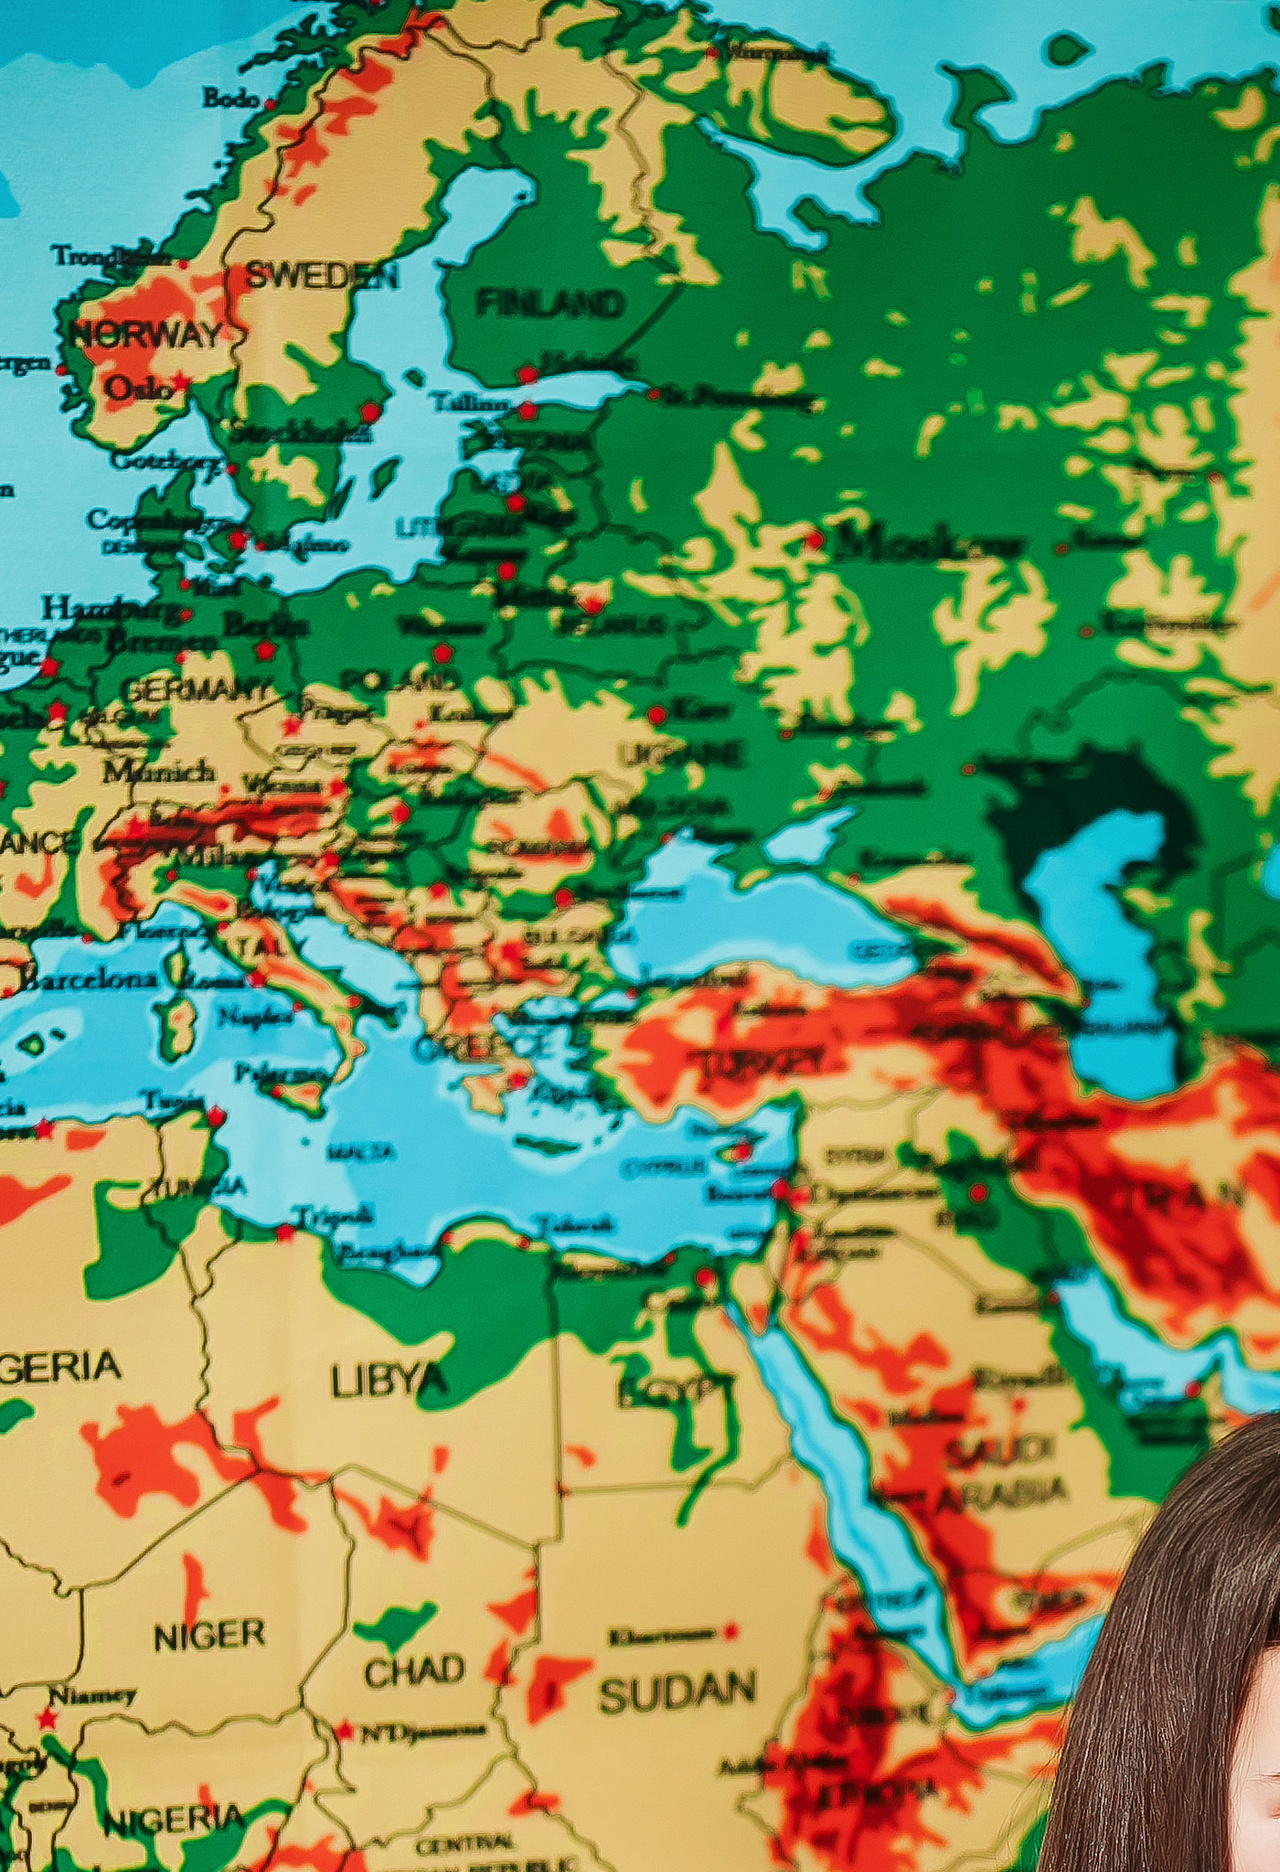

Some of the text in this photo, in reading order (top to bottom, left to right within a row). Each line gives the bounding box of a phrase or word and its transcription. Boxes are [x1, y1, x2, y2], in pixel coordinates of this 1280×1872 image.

[246, 260, 398, 290] SWEDEN
[477, 289, 624, 319] FINLAND
[68, 320, 224, 349] NORWAY
[0, 355, 51, 375] ergen
[103, 375, 174, 402] Oslo
[0, 650, 42, 676] gue
[124, 675, 280, 703] GERMANY
[103, 757, 216, 784] Munich
[0, 828, 80, 854] ANCE
[24, 966, 158, 991] Barcelona
[0, 1350, 124, 1385] GERIA
[331, 1360, 450, 1399] LIBYA
[935, 1476, 1068, 1515] ARABIA
[154, 1618, 267, 1654] NIGER
[364, 1652, 467, 1690] CHAD
[600, 1669, 760, 1717] SUDAN
[104, 1802, 247, 1838] NIGERIA
